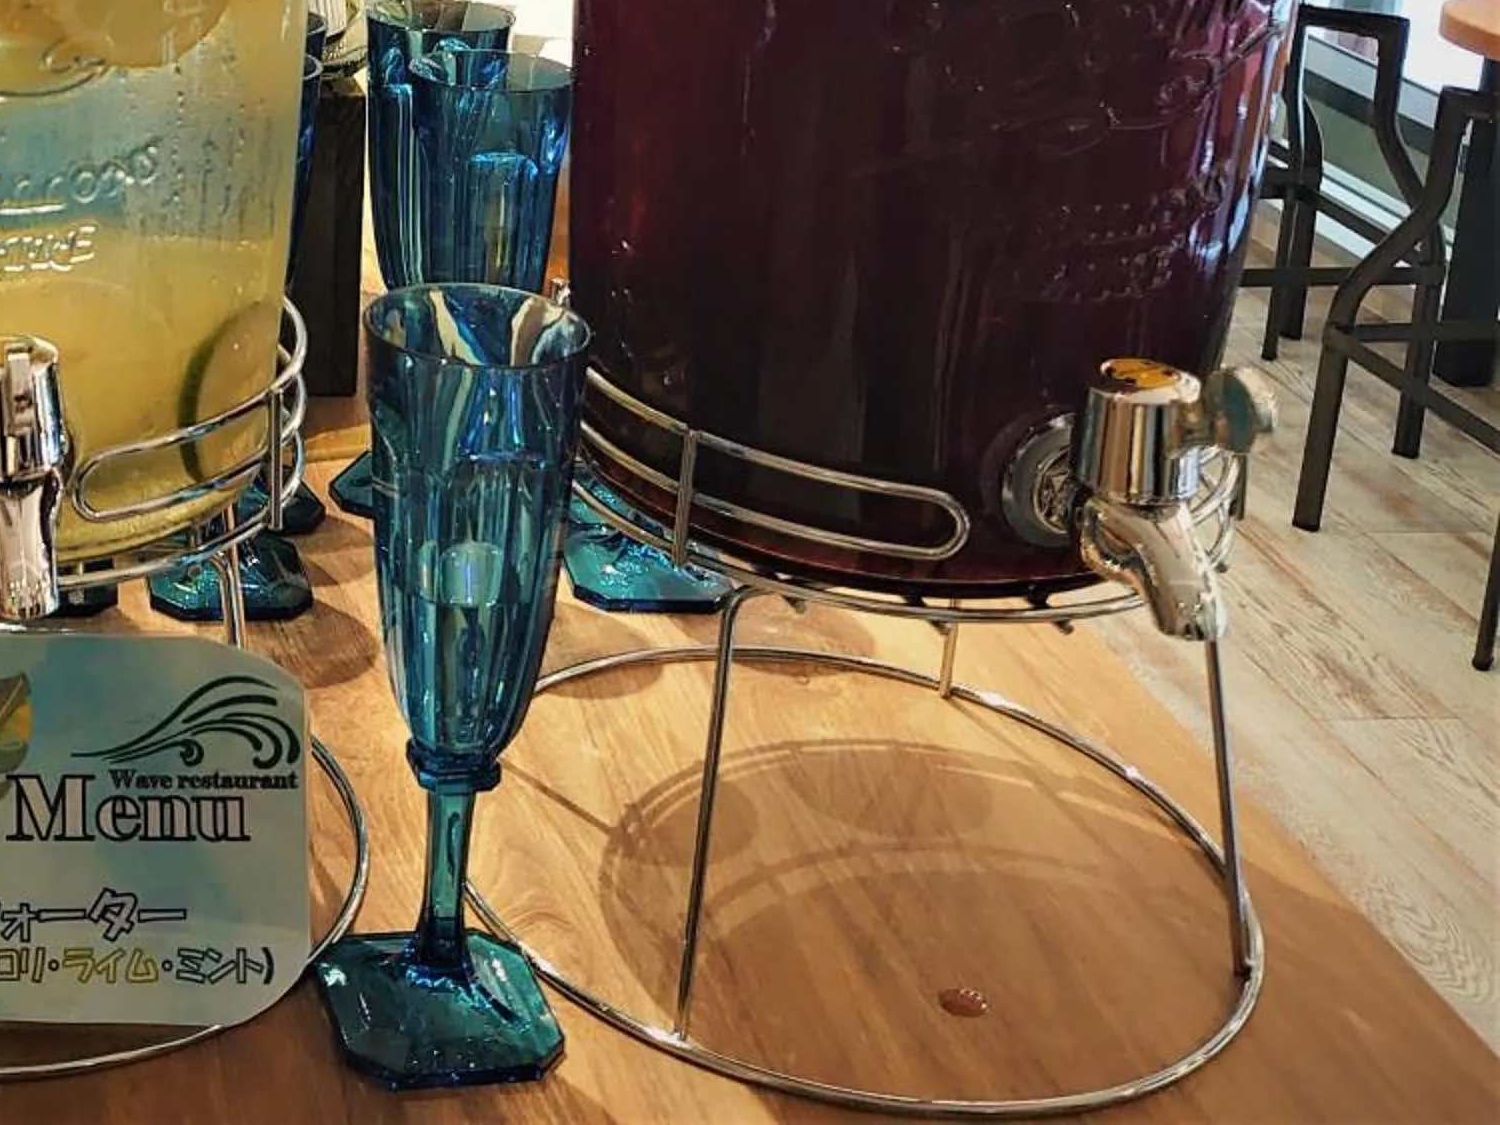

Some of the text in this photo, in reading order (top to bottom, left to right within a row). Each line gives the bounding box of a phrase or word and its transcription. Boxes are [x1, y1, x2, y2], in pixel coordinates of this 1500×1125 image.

[110, 768, 300, 791] Wave restaurant
[5, 774, 252, 843] Menu
